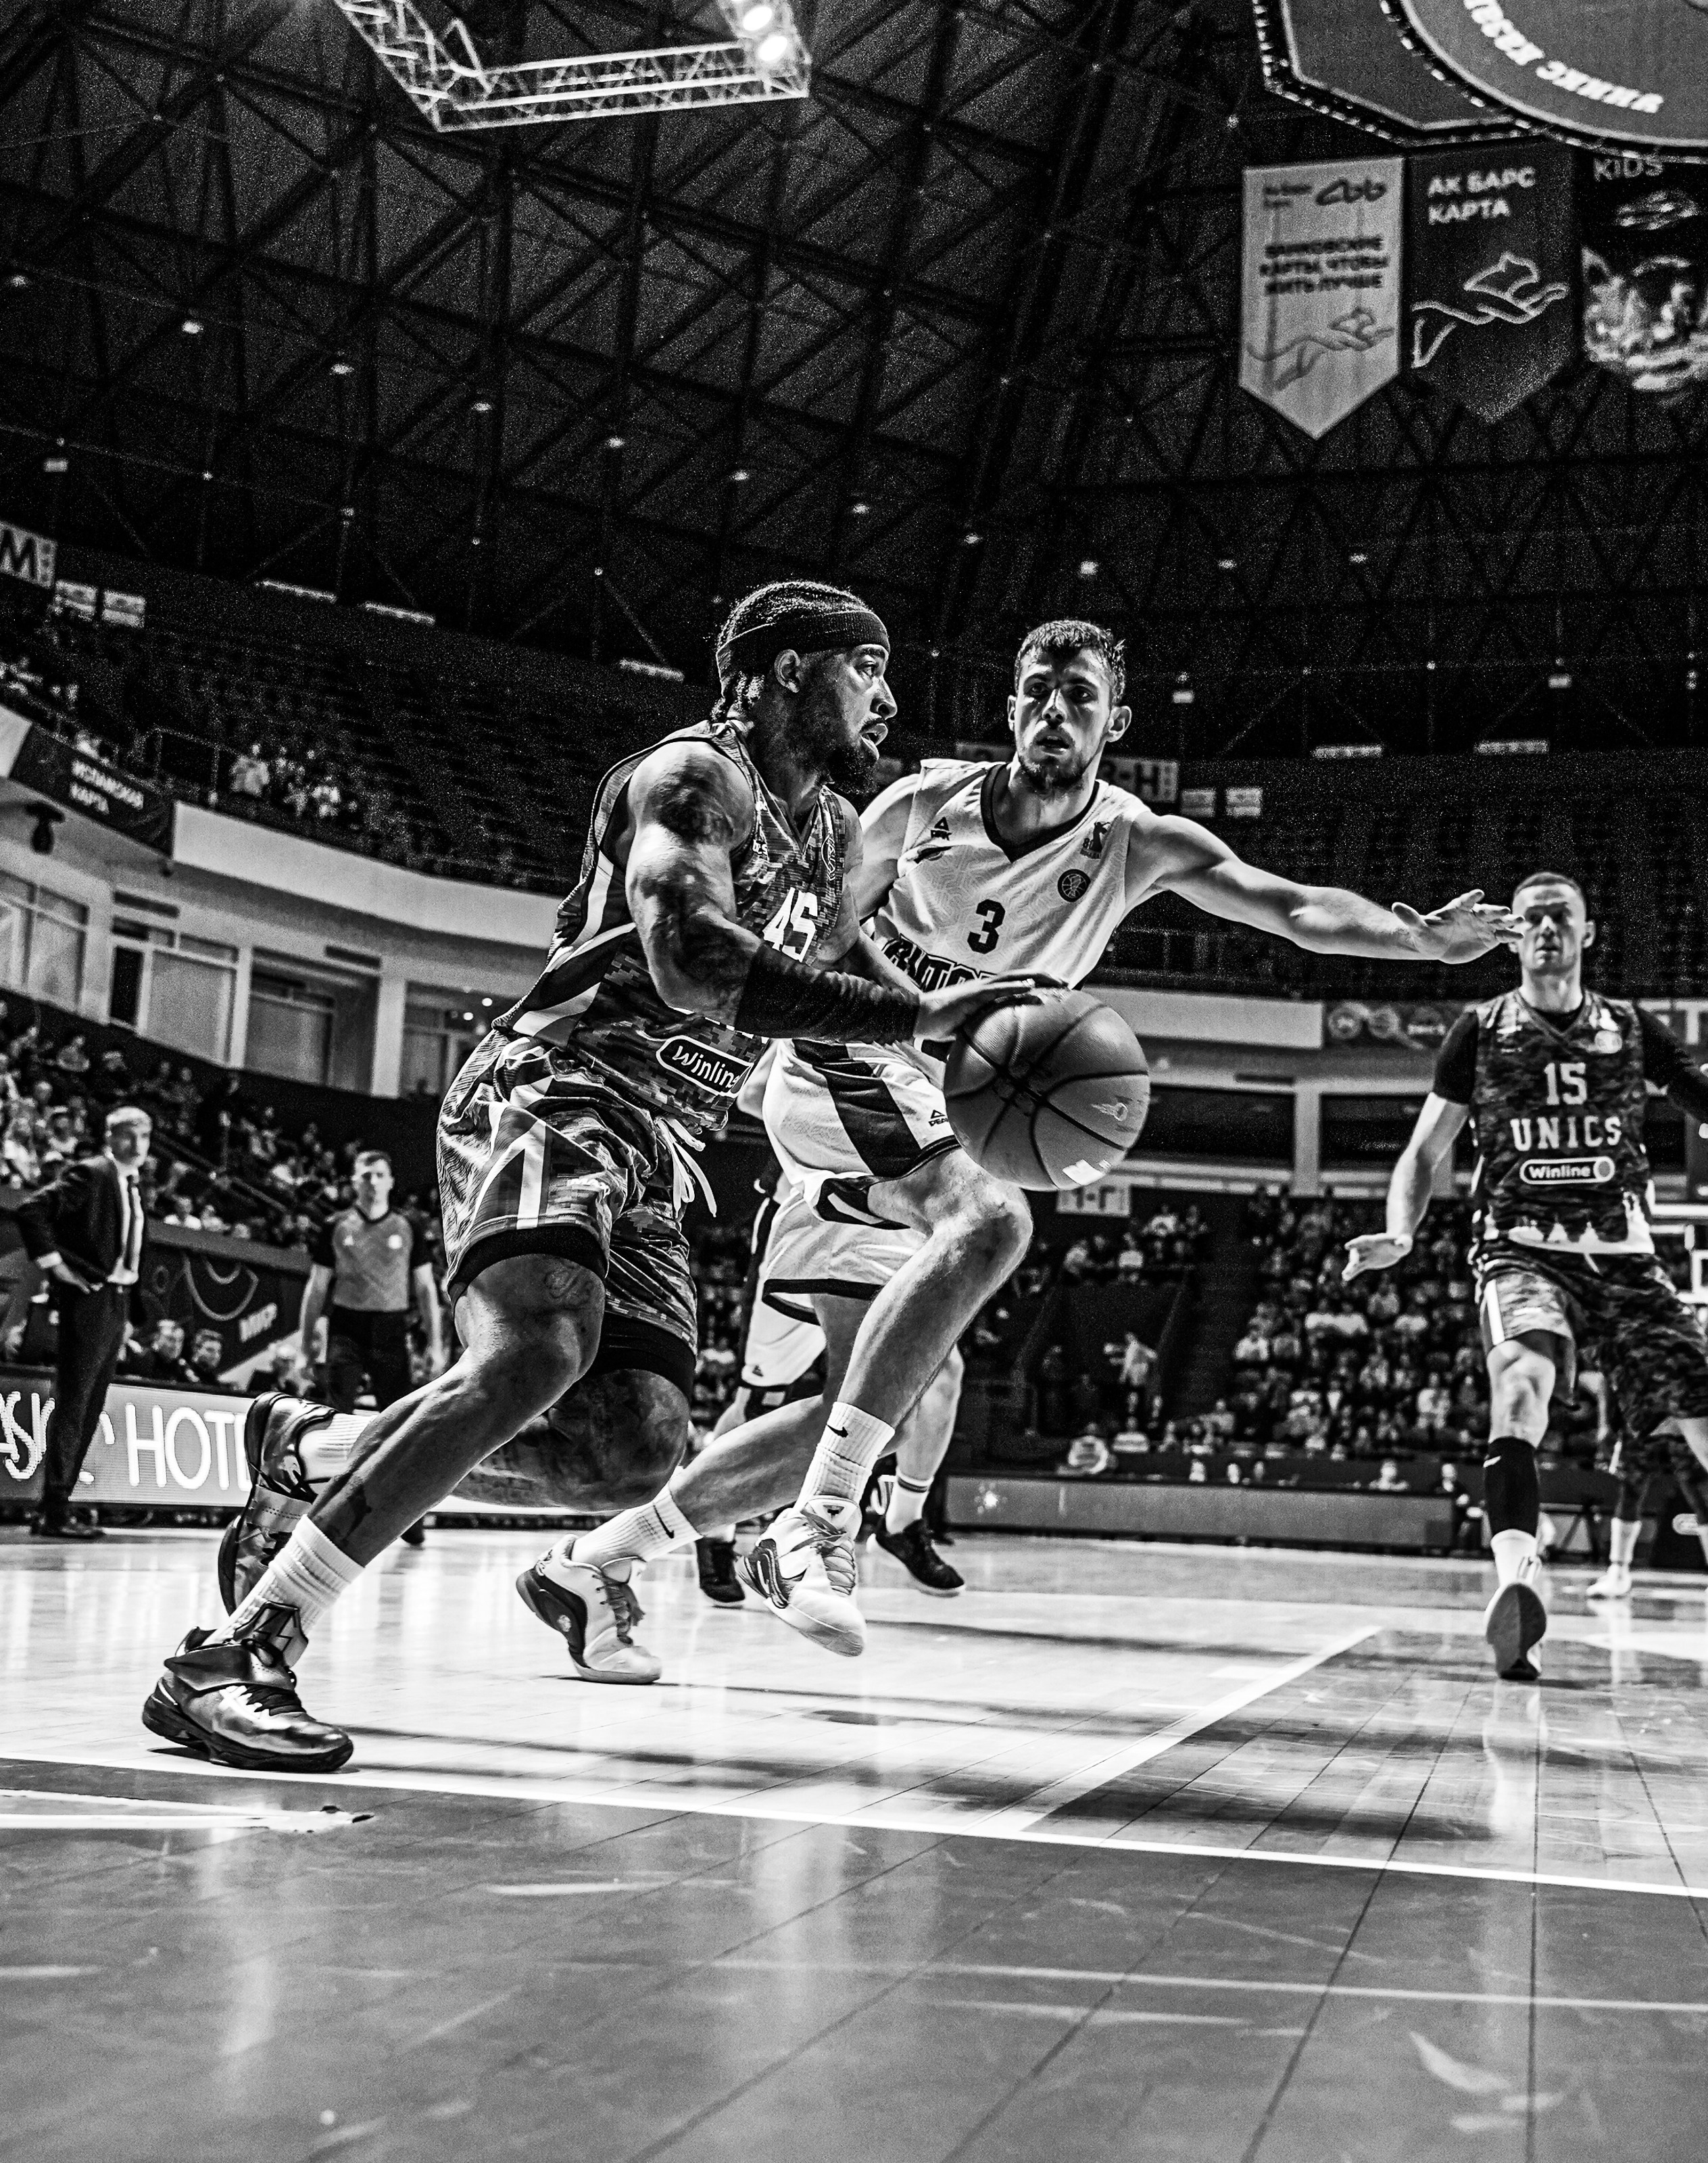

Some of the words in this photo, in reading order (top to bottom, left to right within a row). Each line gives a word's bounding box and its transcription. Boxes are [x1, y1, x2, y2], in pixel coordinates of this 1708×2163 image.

[1466, 166, 1536, 193] БАРС
[1593, 156, 1663, 181] KIDS
[1428, 197, 1511, 225] КАРТА
[762, 887, 818, 963] 45
[967, 899, 1006, 954] 3
[1544, 1062, 1588, 1105] 15
[1510, 1116, 1622, 1151] UNICS
[1528, 1165, 1591, 1178] Winline
